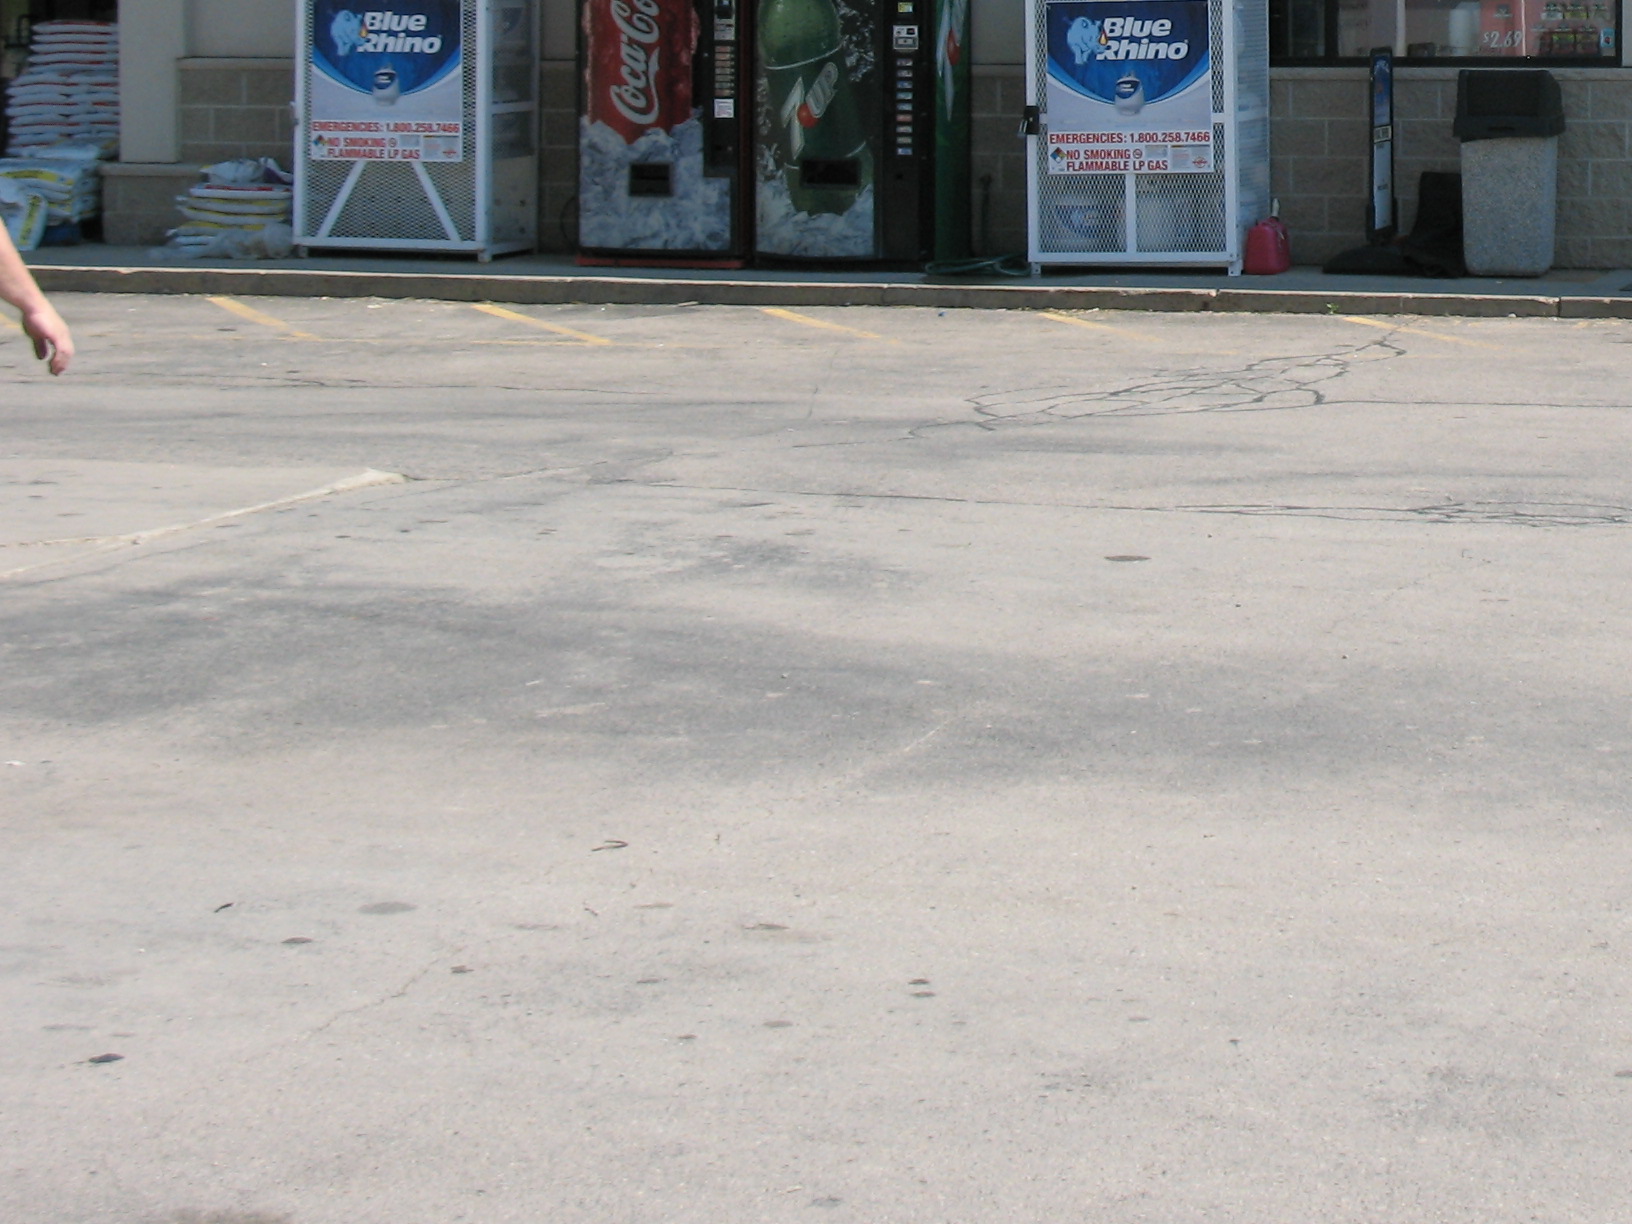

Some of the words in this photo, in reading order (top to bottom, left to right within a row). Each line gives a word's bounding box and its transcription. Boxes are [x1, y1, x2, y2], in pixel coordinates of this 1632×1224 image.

[364, 11, 428, 32] Blue
[1103, 16, 1173, 38] Blue
[356, 32, 442, 54] Rhino
[1483, 30, 1523, 49] $2.69
[1096, 38, 1189, 61] Rhino
[312, 121, 383, 132] EMERGENCIES:
[327, 137, 339, 147] NO
[343, 137, 386, 148] SMOKING
[1050, 132, 1127, 144] EMERGENCIES:
[1130, 131, 1211, 143] 1.800.258.7466
[327, 148, 385, 159] FLAMMABLE
[388, 148, 400, 159] LP
[401, 148, 421, 159] GAS
[1066, 149, 1080, 160] NO
[1084, 149, 1131, 160] SMOKING
[1066, 160, 1130, 172] FLAMMABLE
[1133, 160, 1146, 171] LP
[1147, 159, 1168, 171] GAS
